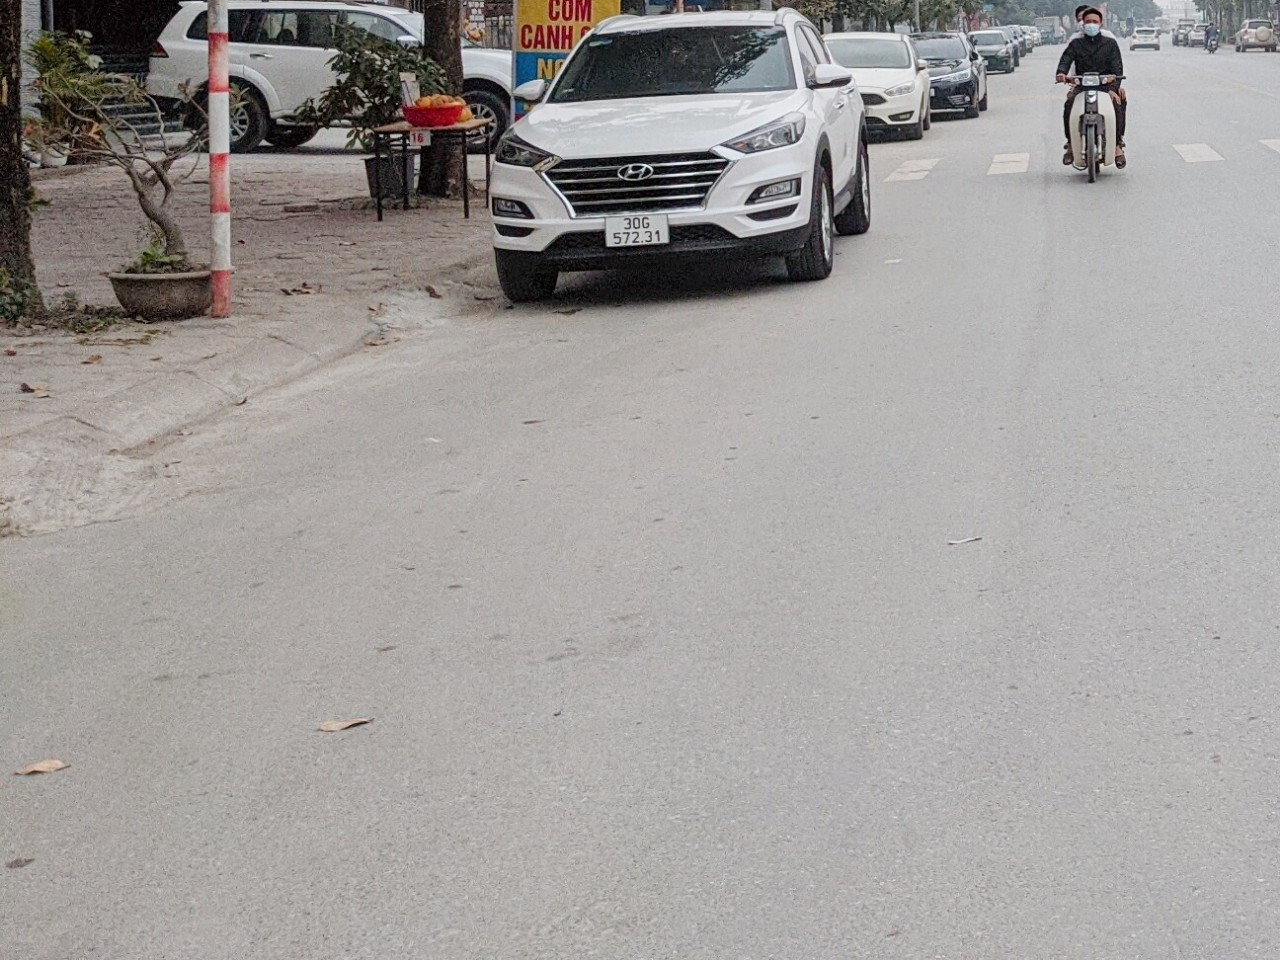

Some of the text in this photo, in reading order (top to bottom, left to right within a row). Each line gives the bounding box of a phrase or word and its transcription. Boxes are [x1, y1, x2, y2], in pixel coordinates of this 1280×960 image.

[521, 24, 573, 50] CANH
[411, 131, 425, 144] 16
[623, 216, 650, 230] 30G
[613, 229, 661, 245] 572.31
